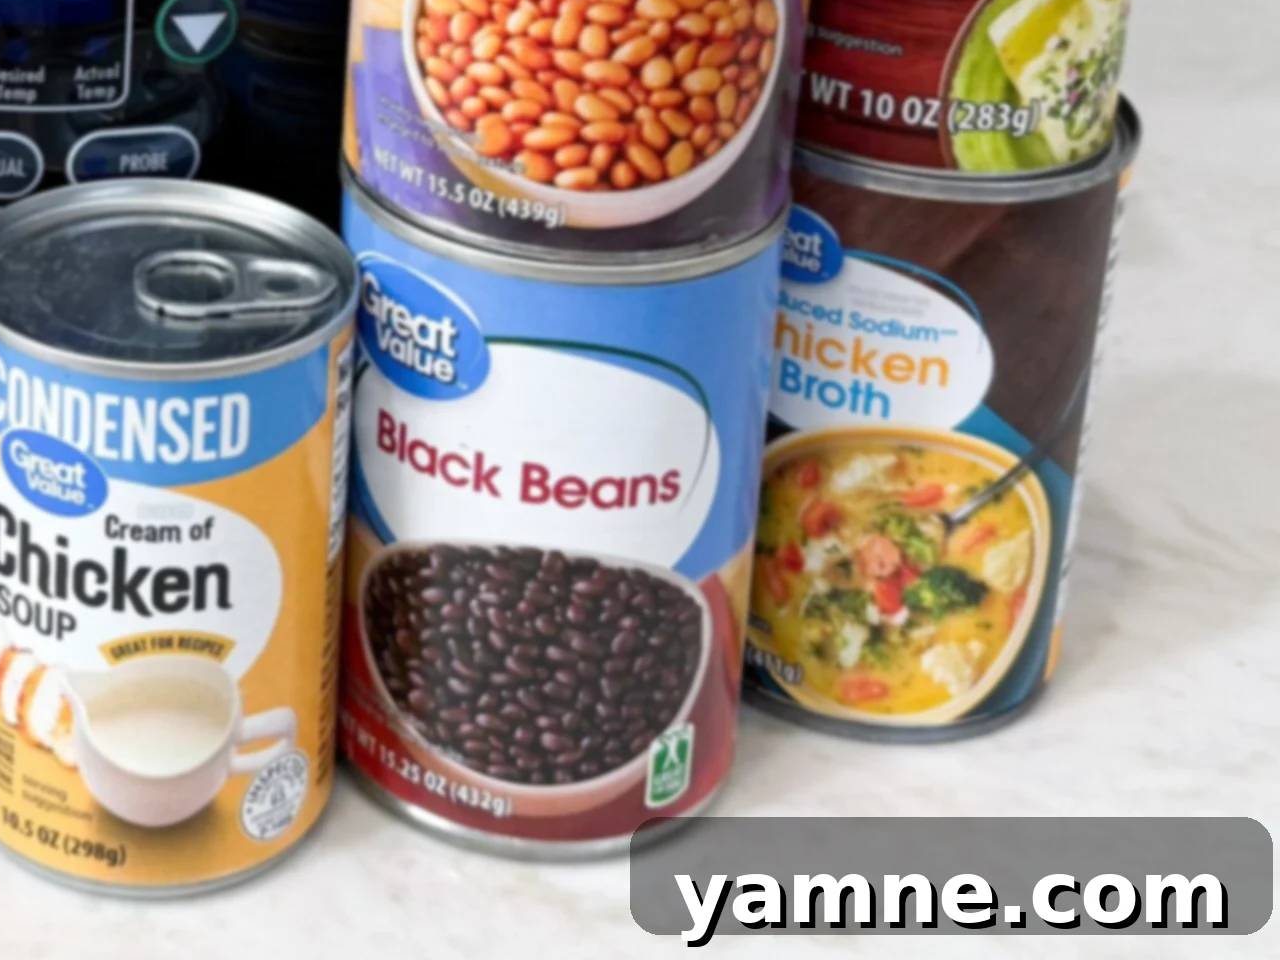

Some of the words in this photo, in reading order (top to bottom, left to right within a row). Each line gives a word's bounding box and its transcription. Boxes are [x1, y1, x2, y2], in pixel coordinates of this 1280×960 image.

[74, 62, 120, 82] Actual
[76, 83, 117, 103] Temp
[810, 71, 853, 110] WT
[860, 89, 895, 120] 10
[901, 98, 942, 128] OZ
[948, 98, 1042, 137] (283g)
[119, 151, 169, 174] PROBE
[373, 144, 397, 174] NET
[399, 160, 425, 188] WT
[428, 172, 466, 204] 15.5
[469, 187, 496, 213] OZ
[781, 247, 821, 274] alue
[782, 228, 823, 257] eat
[360, 271, 458, 358] Great
[780, 289, 843, 326] duced
[376, 326, 456, 386] Value
[773, 307, 950, 388] hicken
[778, 356, 891, 420] Broth
[8, 439, 88, 488] Great
[376, 408, 503, 499] Black
[519, 461, 682, 510] Beans
[24, 468, 86, 506] Value
[104, 512, 182, 544] Cream
[188, 516, 214, 541] of
[109, 637, 147, 661] GREAT
[423, 770, 447, 798] OZ
[449, 781, 513, 819] (432g)
[1, 805, 35, 839] 10.5
[36, 823, 61, 851] OZ
[62, 831, 127, 869] (298g)
